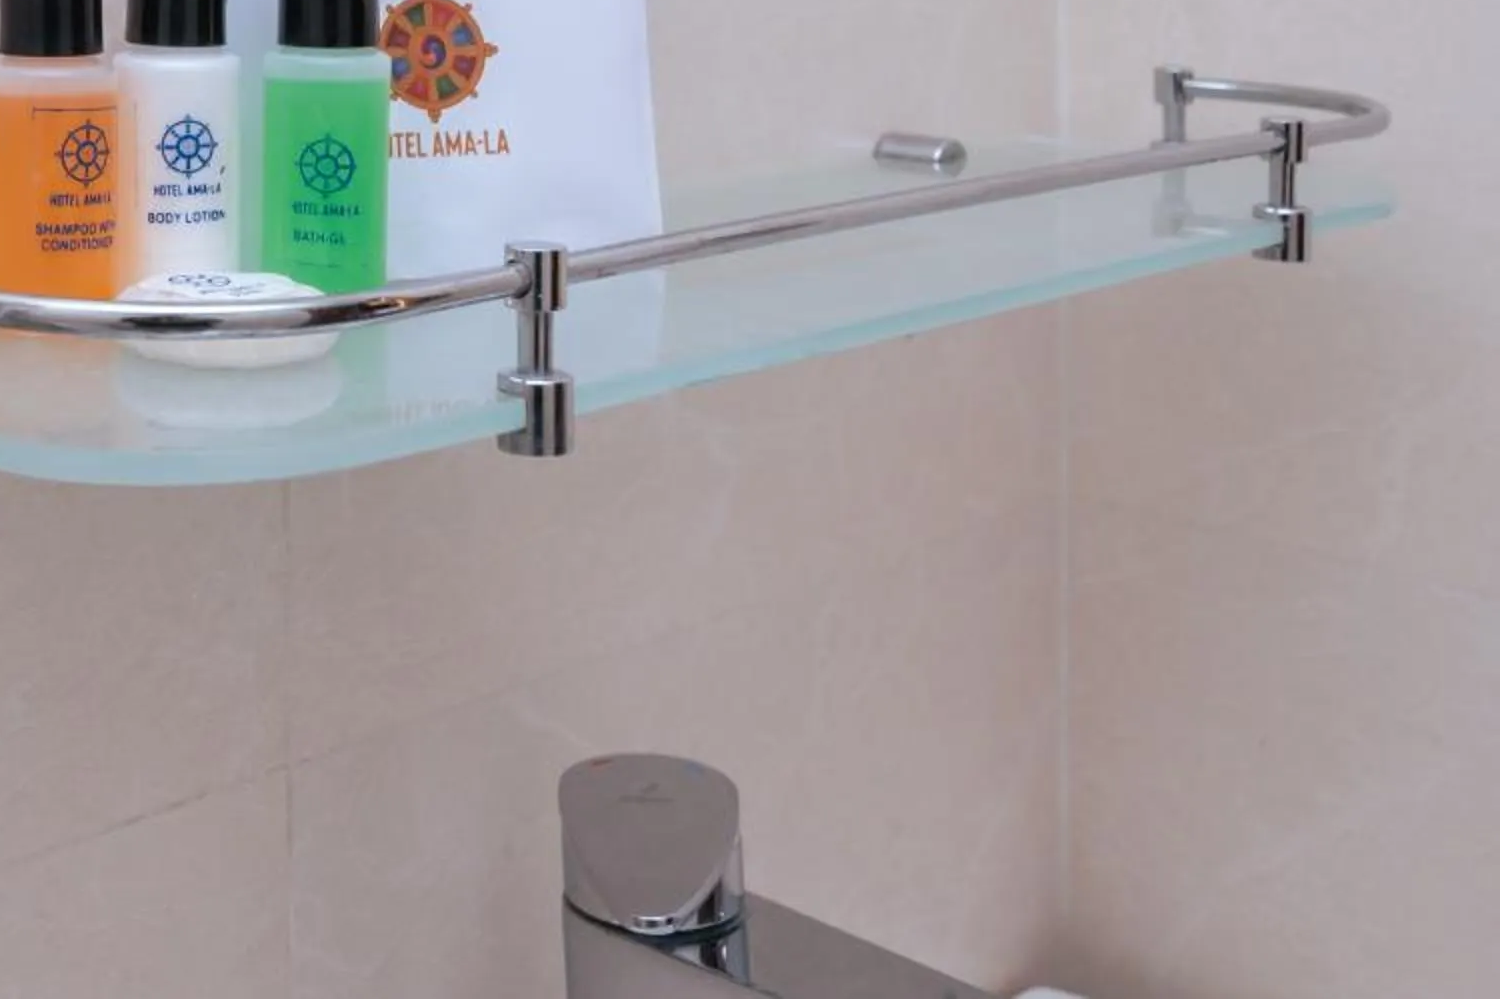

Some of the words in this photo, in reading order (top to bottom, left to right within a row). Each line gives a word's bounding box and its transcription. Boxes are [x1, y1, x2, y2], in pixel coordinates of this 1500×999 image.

[388, 132, 429, 158] TEL
[432, 129, 510, 157] AMA-LA
[153, 184, 183, 197] HOTEL
[147, 211, 181, 224] BODY
[185, 209, 226, 223] LOTION
[35, 222, 97, 235] SHAMPOO
